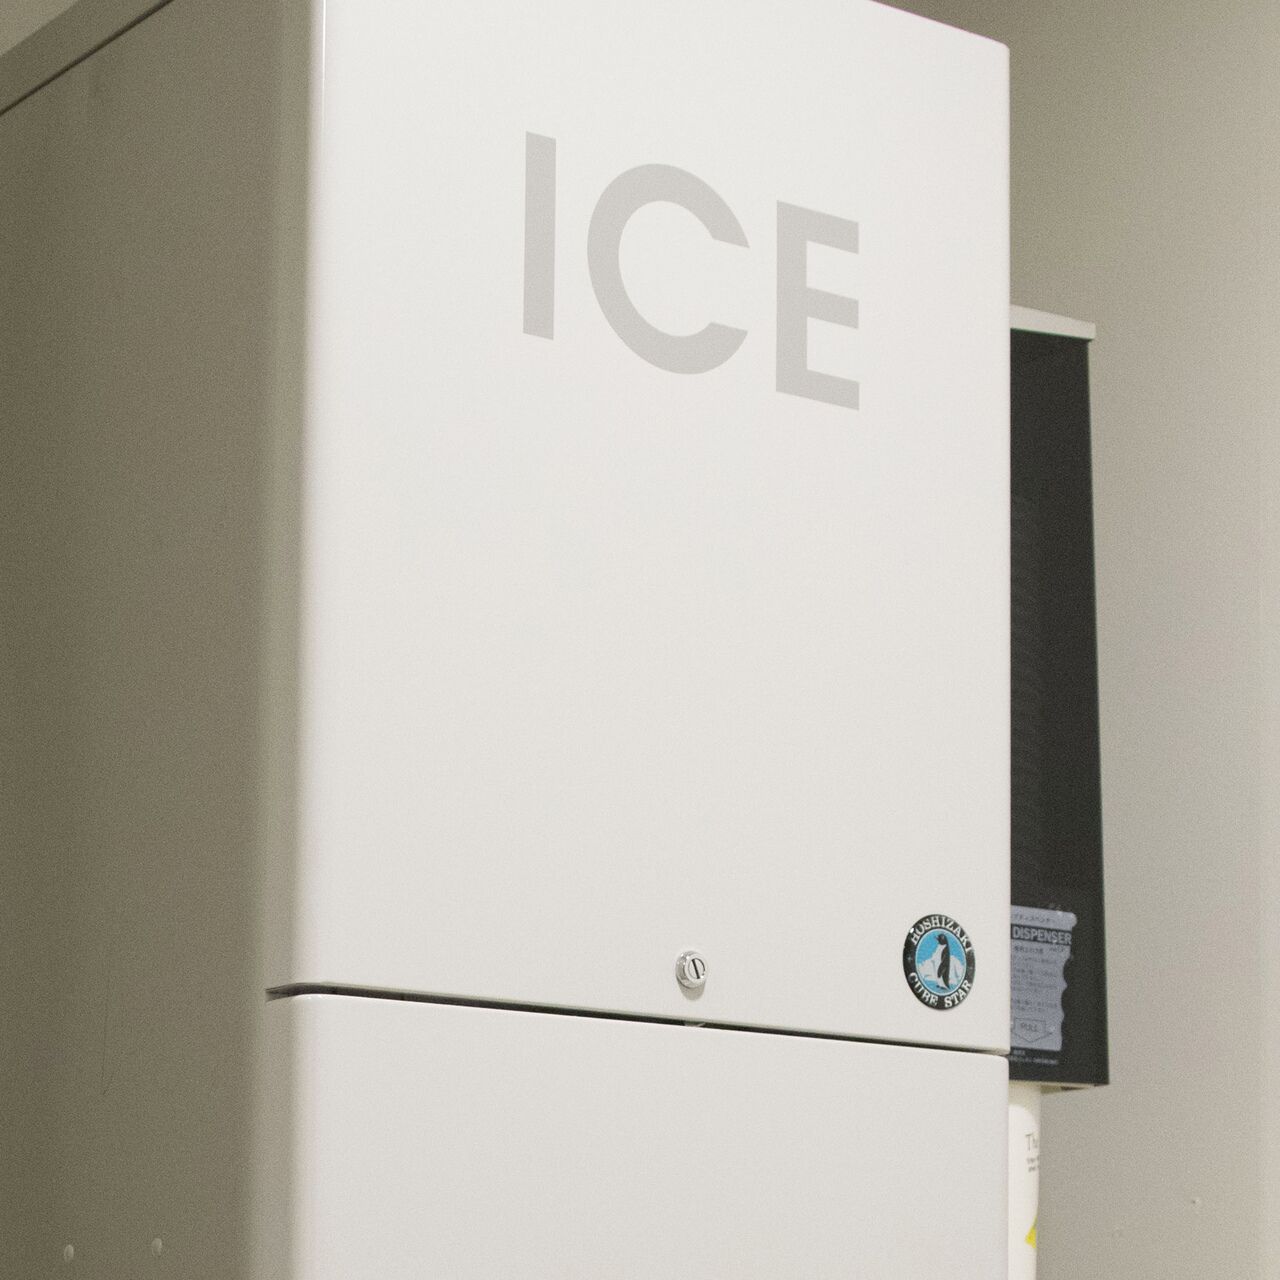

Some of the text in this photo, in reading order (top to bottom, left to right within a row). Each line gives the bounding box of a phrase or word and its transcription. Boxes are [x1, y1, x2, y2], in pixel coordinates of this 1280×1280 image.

[522, 131, 860, 412] ICE
[910, 915, 973, 952] HOSHIZAKI
[1013, 926, 1072, 945] DISPENSER
[944, 980, 972, 1008] STAR
